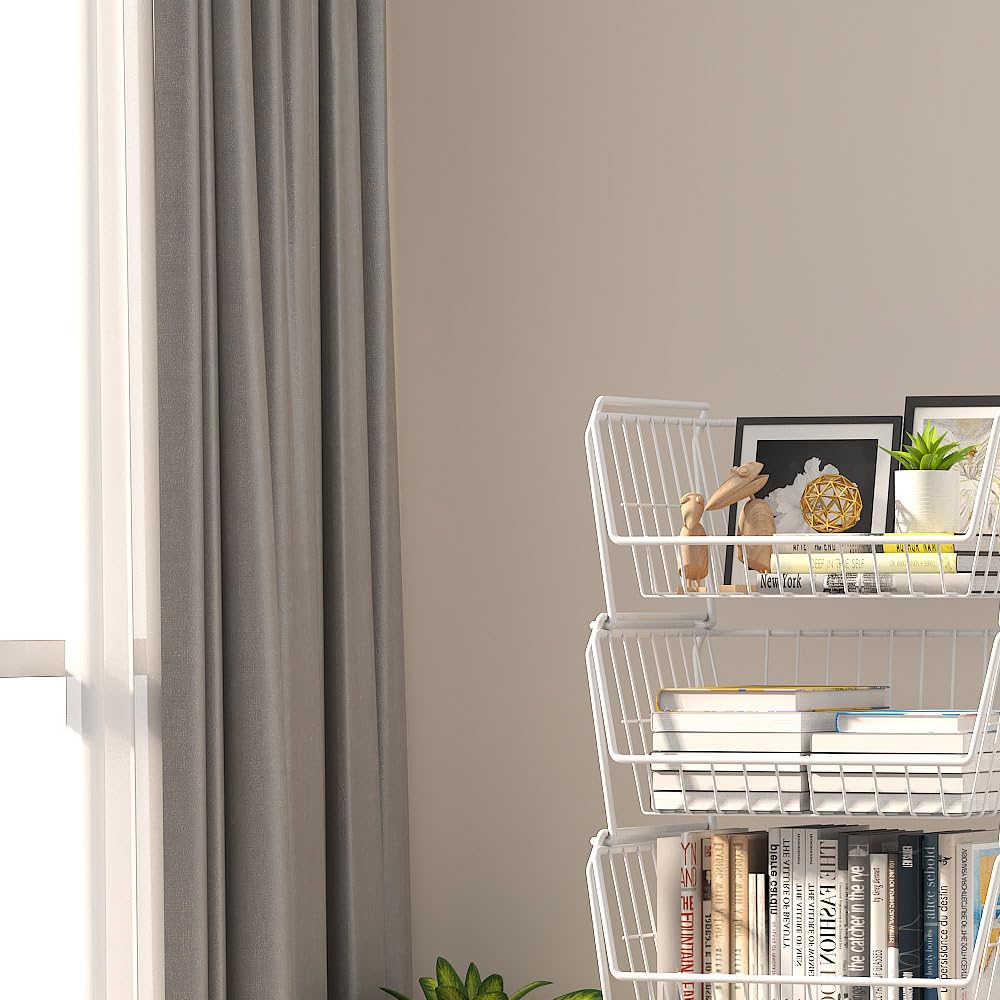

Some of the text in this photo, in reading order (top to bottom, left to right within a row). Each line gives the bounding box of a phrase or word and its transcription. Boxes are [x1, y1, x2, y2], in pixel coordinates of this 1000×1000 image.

[760, 573, 802, 589] New York
[940, 885, 948, 912] destin
[848, 866, 869, 972] the catcher in the rye
[924, 846, 935, 976] lovely bones alice sebold
[940, 914, 948, 926] du
[872, 950, 882, 971] GLASSES
